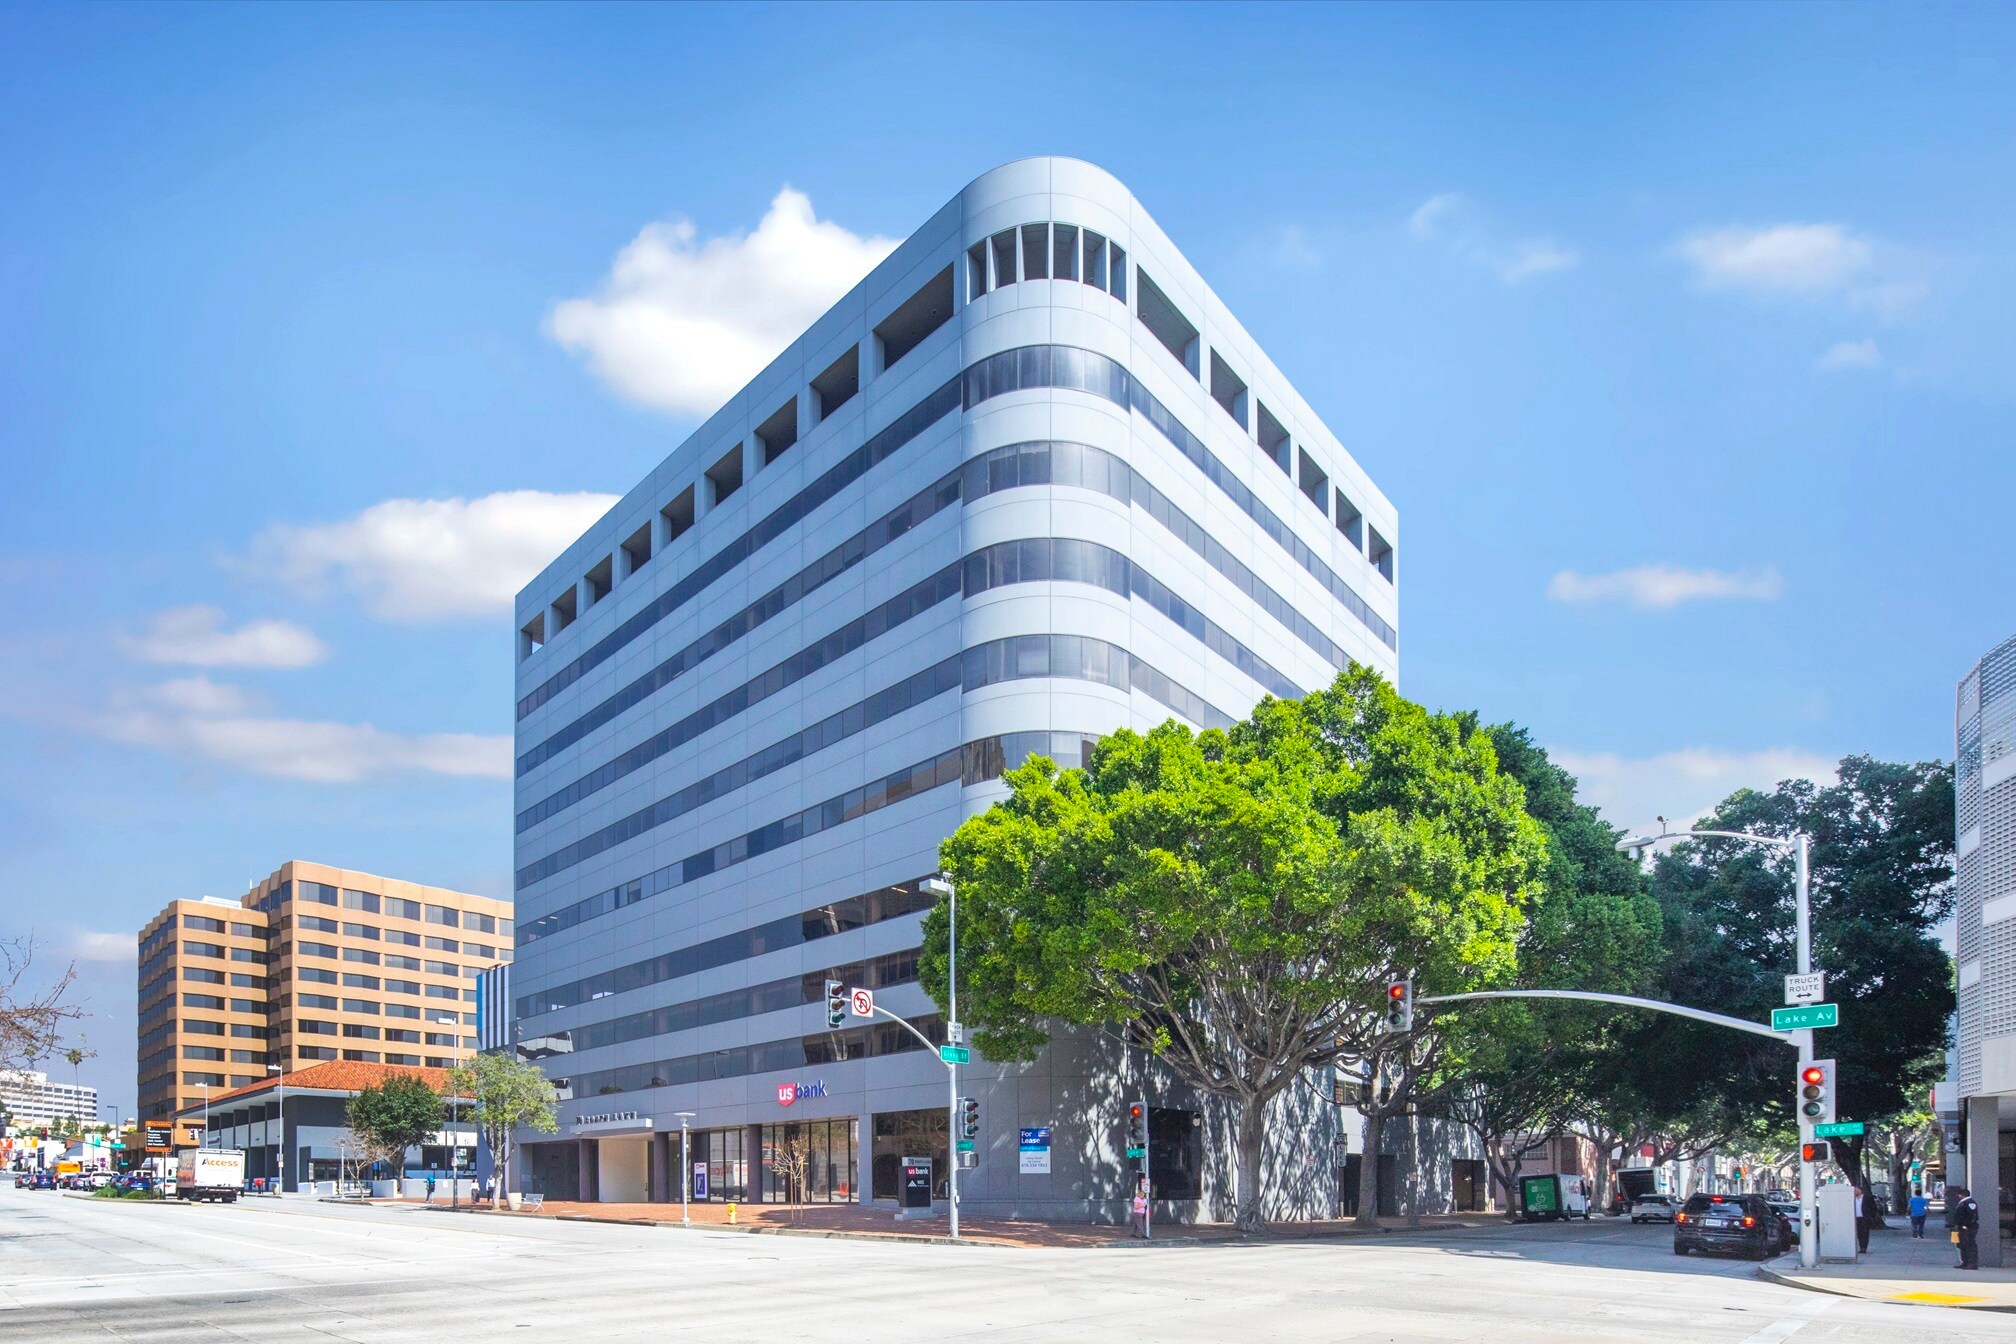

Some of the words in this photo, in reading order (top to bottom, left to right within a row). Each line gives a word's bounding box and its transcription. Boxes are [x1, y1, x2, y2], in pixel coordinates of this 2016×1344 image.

[1789, 984, 1820, 992] ROUTE
[1776, 1014, 1807, 1024] Lake
[1816, 1012, 1833, 1020] Av
[1816, 1125, 1845, 1134] Lake
[201, 1157, 239, 1167] Access
